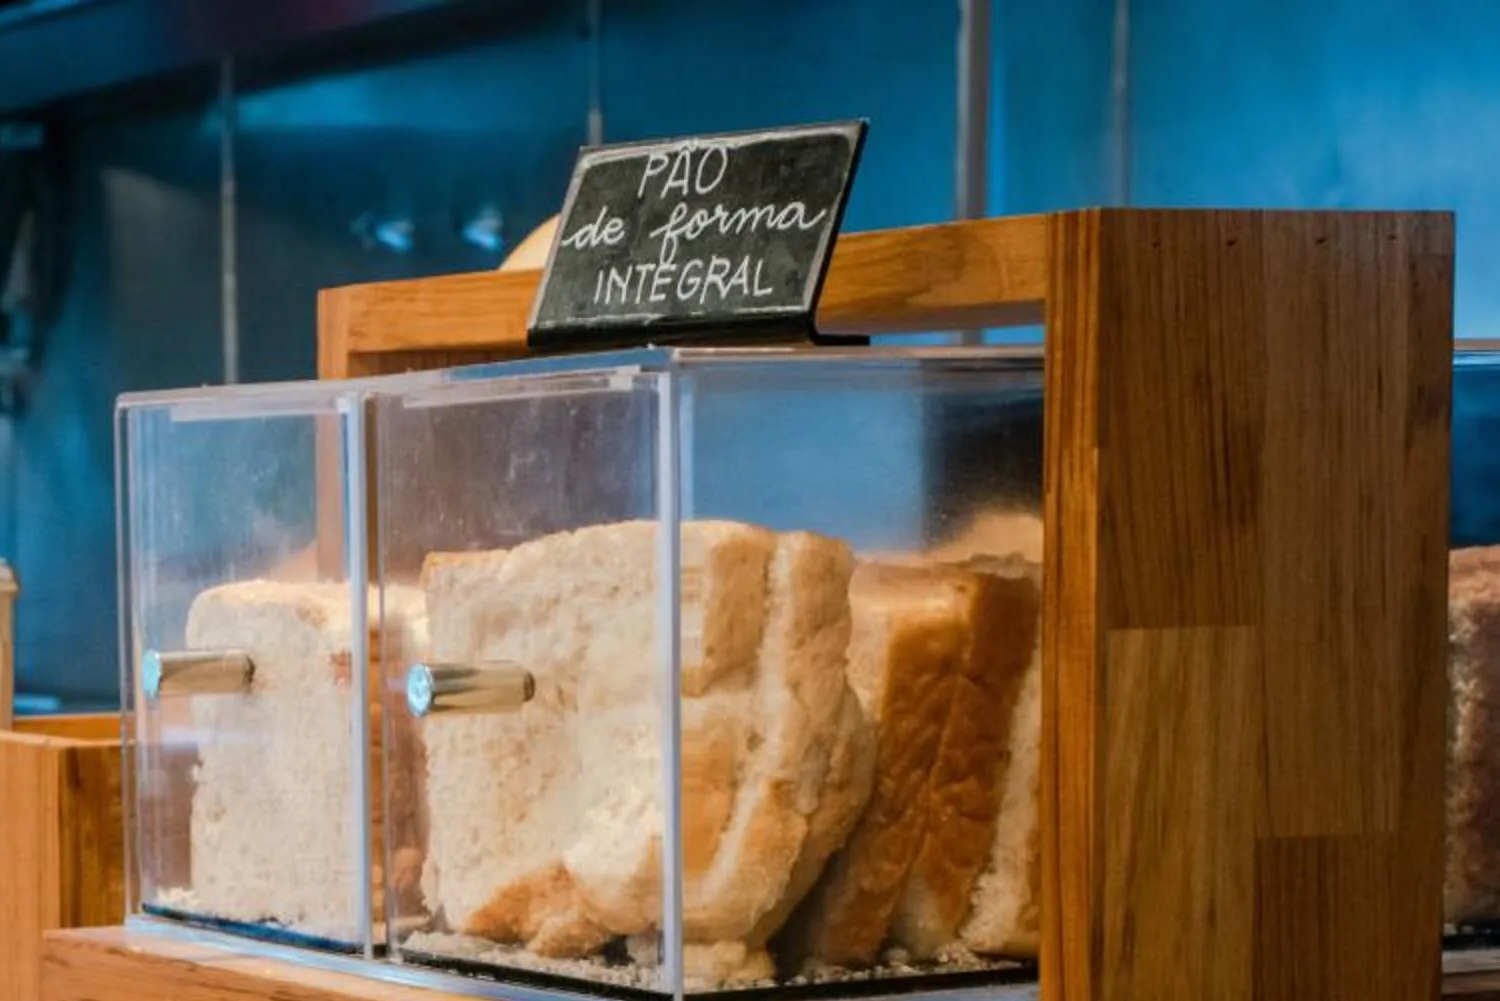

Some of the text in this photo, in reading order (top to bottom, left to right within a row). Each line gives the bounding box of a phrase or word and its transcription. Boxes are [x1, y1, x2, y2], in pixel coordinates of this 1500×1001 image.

[637, 137, 728, 199] PÃO
[561, 201, 827, 265] de forma
[593, 255, 773, 304] INTEGRAL
